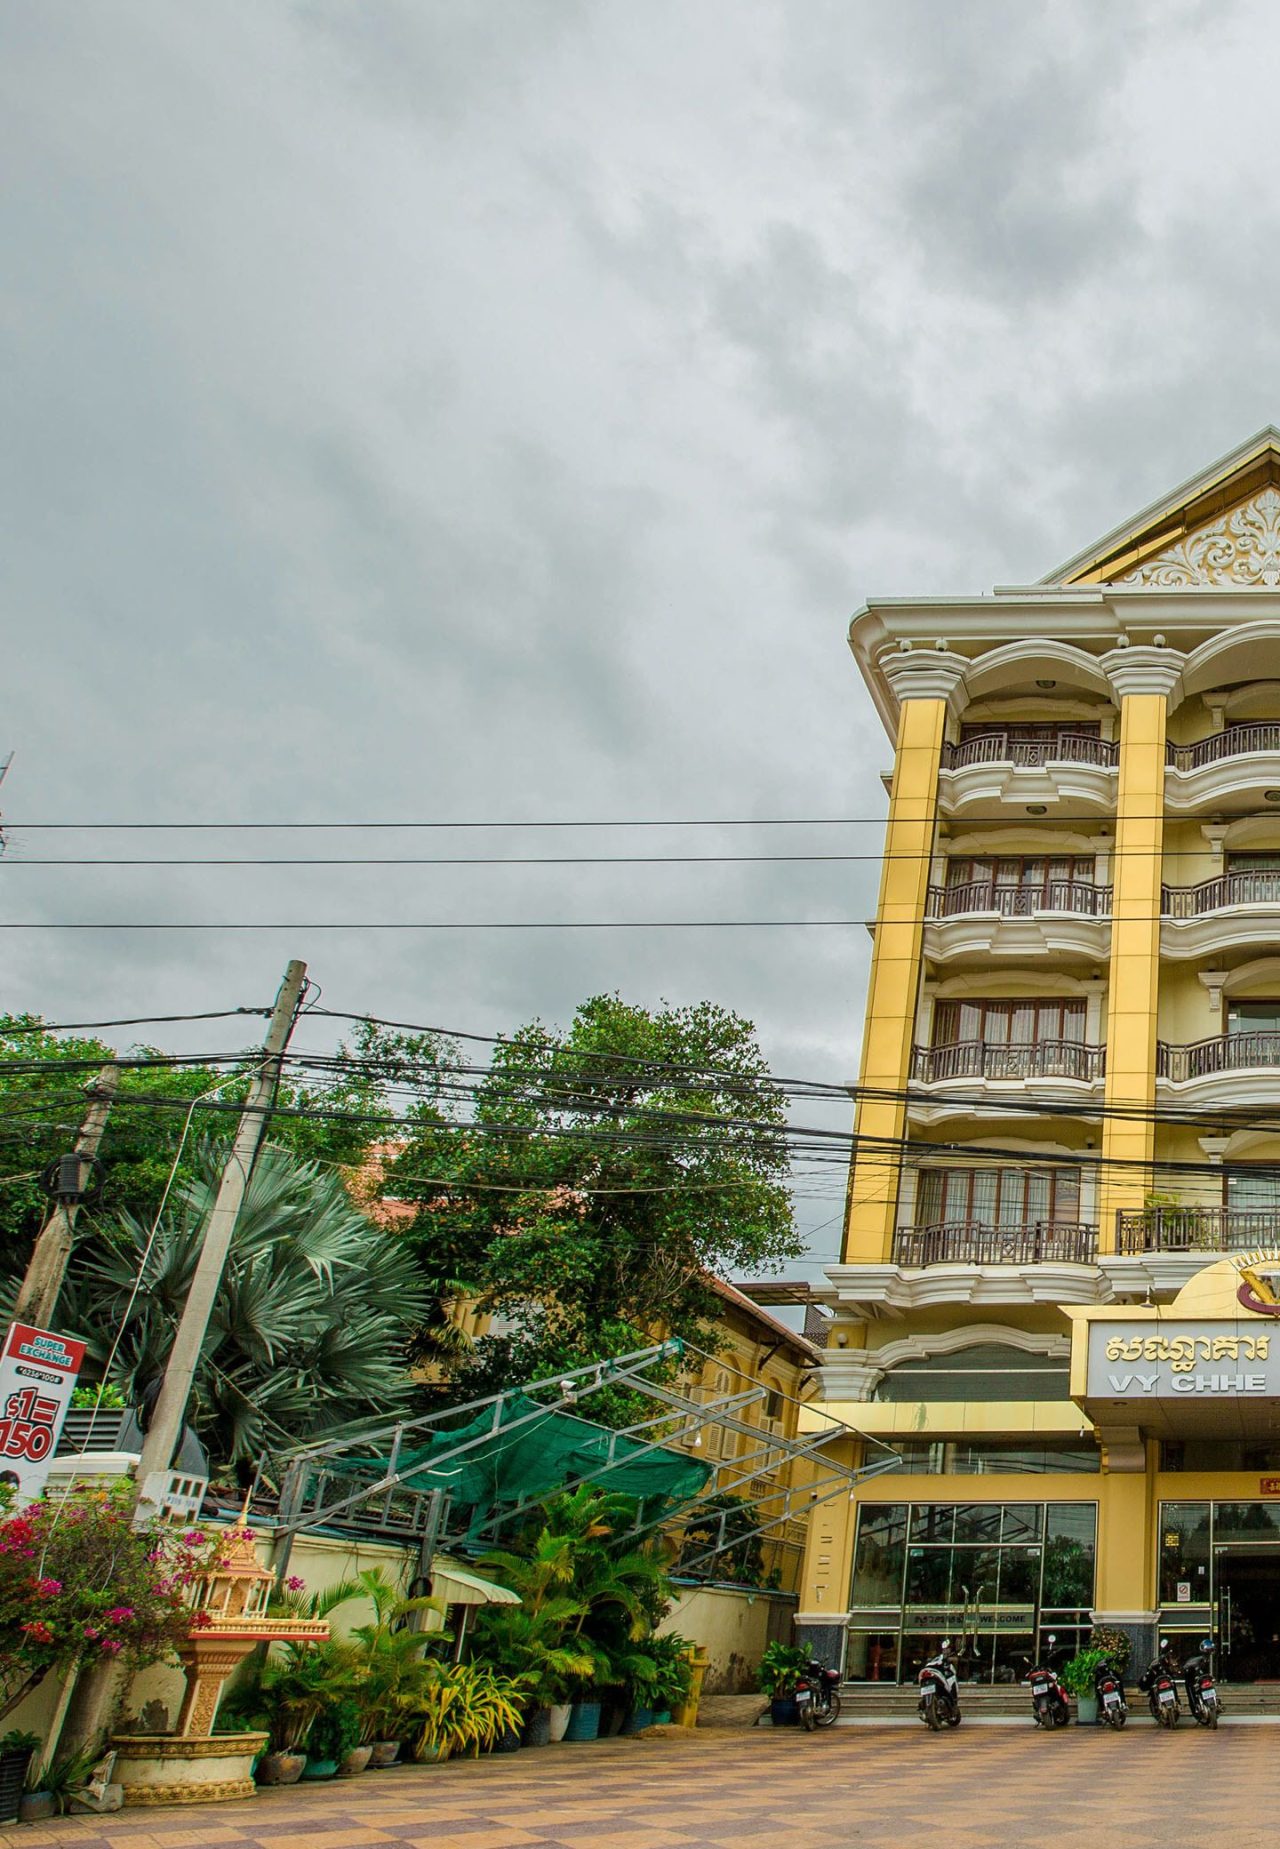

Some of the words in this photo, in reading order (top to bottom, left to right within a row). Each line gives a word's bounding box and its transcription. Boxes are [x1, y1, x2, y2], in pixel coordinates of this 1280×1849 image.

[34, 1336, 66, 1354] SUPER
[19, 1343, 74, 1367] EXCHANGE
[1108, 1375, 1161, 1392] VY
[1171, 1374, 1266, 1392] CHHE
